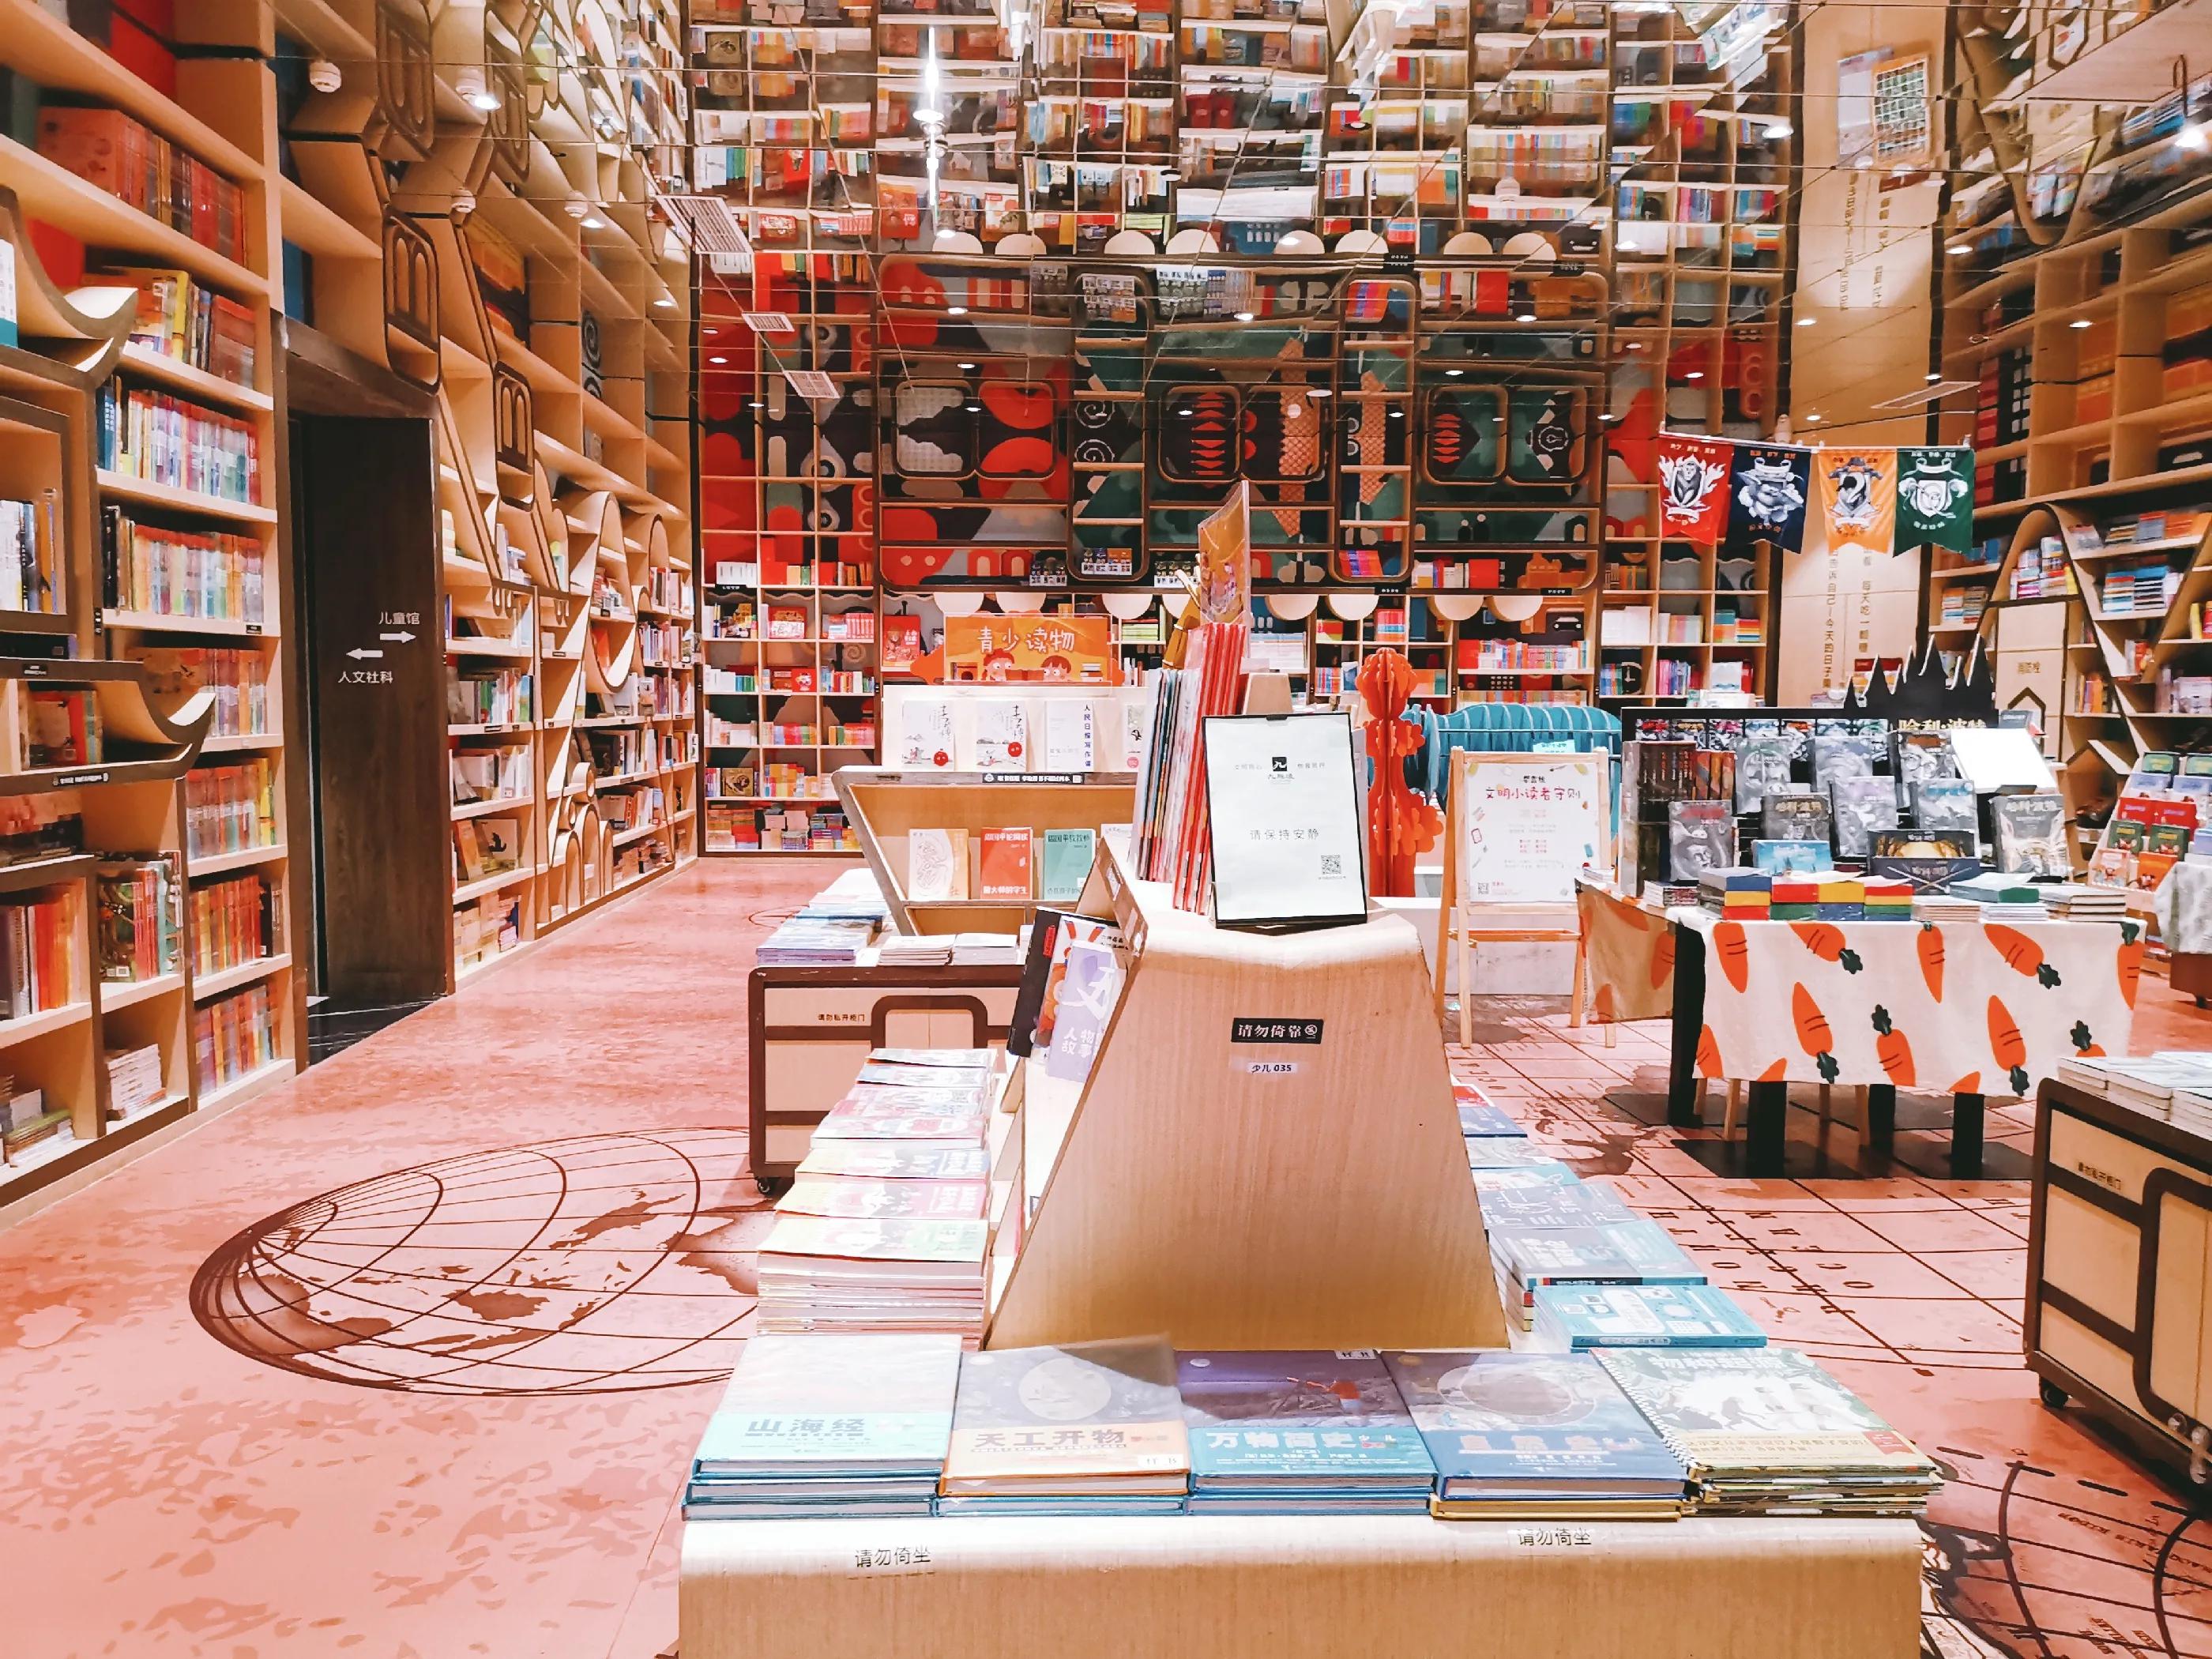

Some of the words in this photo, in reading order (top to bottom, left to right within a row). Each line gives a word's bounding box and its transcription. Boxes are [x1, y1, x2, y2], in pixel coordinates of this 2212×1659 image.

[379, 611, 419, 625] 儿童馆
[978, 626, 1074, 653] 青少读物
[338, 671, 393, 684] 人文社科
[1486, 786, 1581, 800] 文明小读者守则
[1250, 828, 1319, 840] 请保持安静
[1238, 1025, 1301, 1037] 请勿倚靠
[1252, 1064, 1271, 1073] 少儿
[748, 1419, 865, 1432] 山海经
[975, 1425, 1125, 1447] 天工开物
[1206, 1431, 1356, 1448] 万物简史
[1518, 1528, 1592, 1547] 请勿倚坐
[854, 1546, 931, 1568] 请勿倚坐
